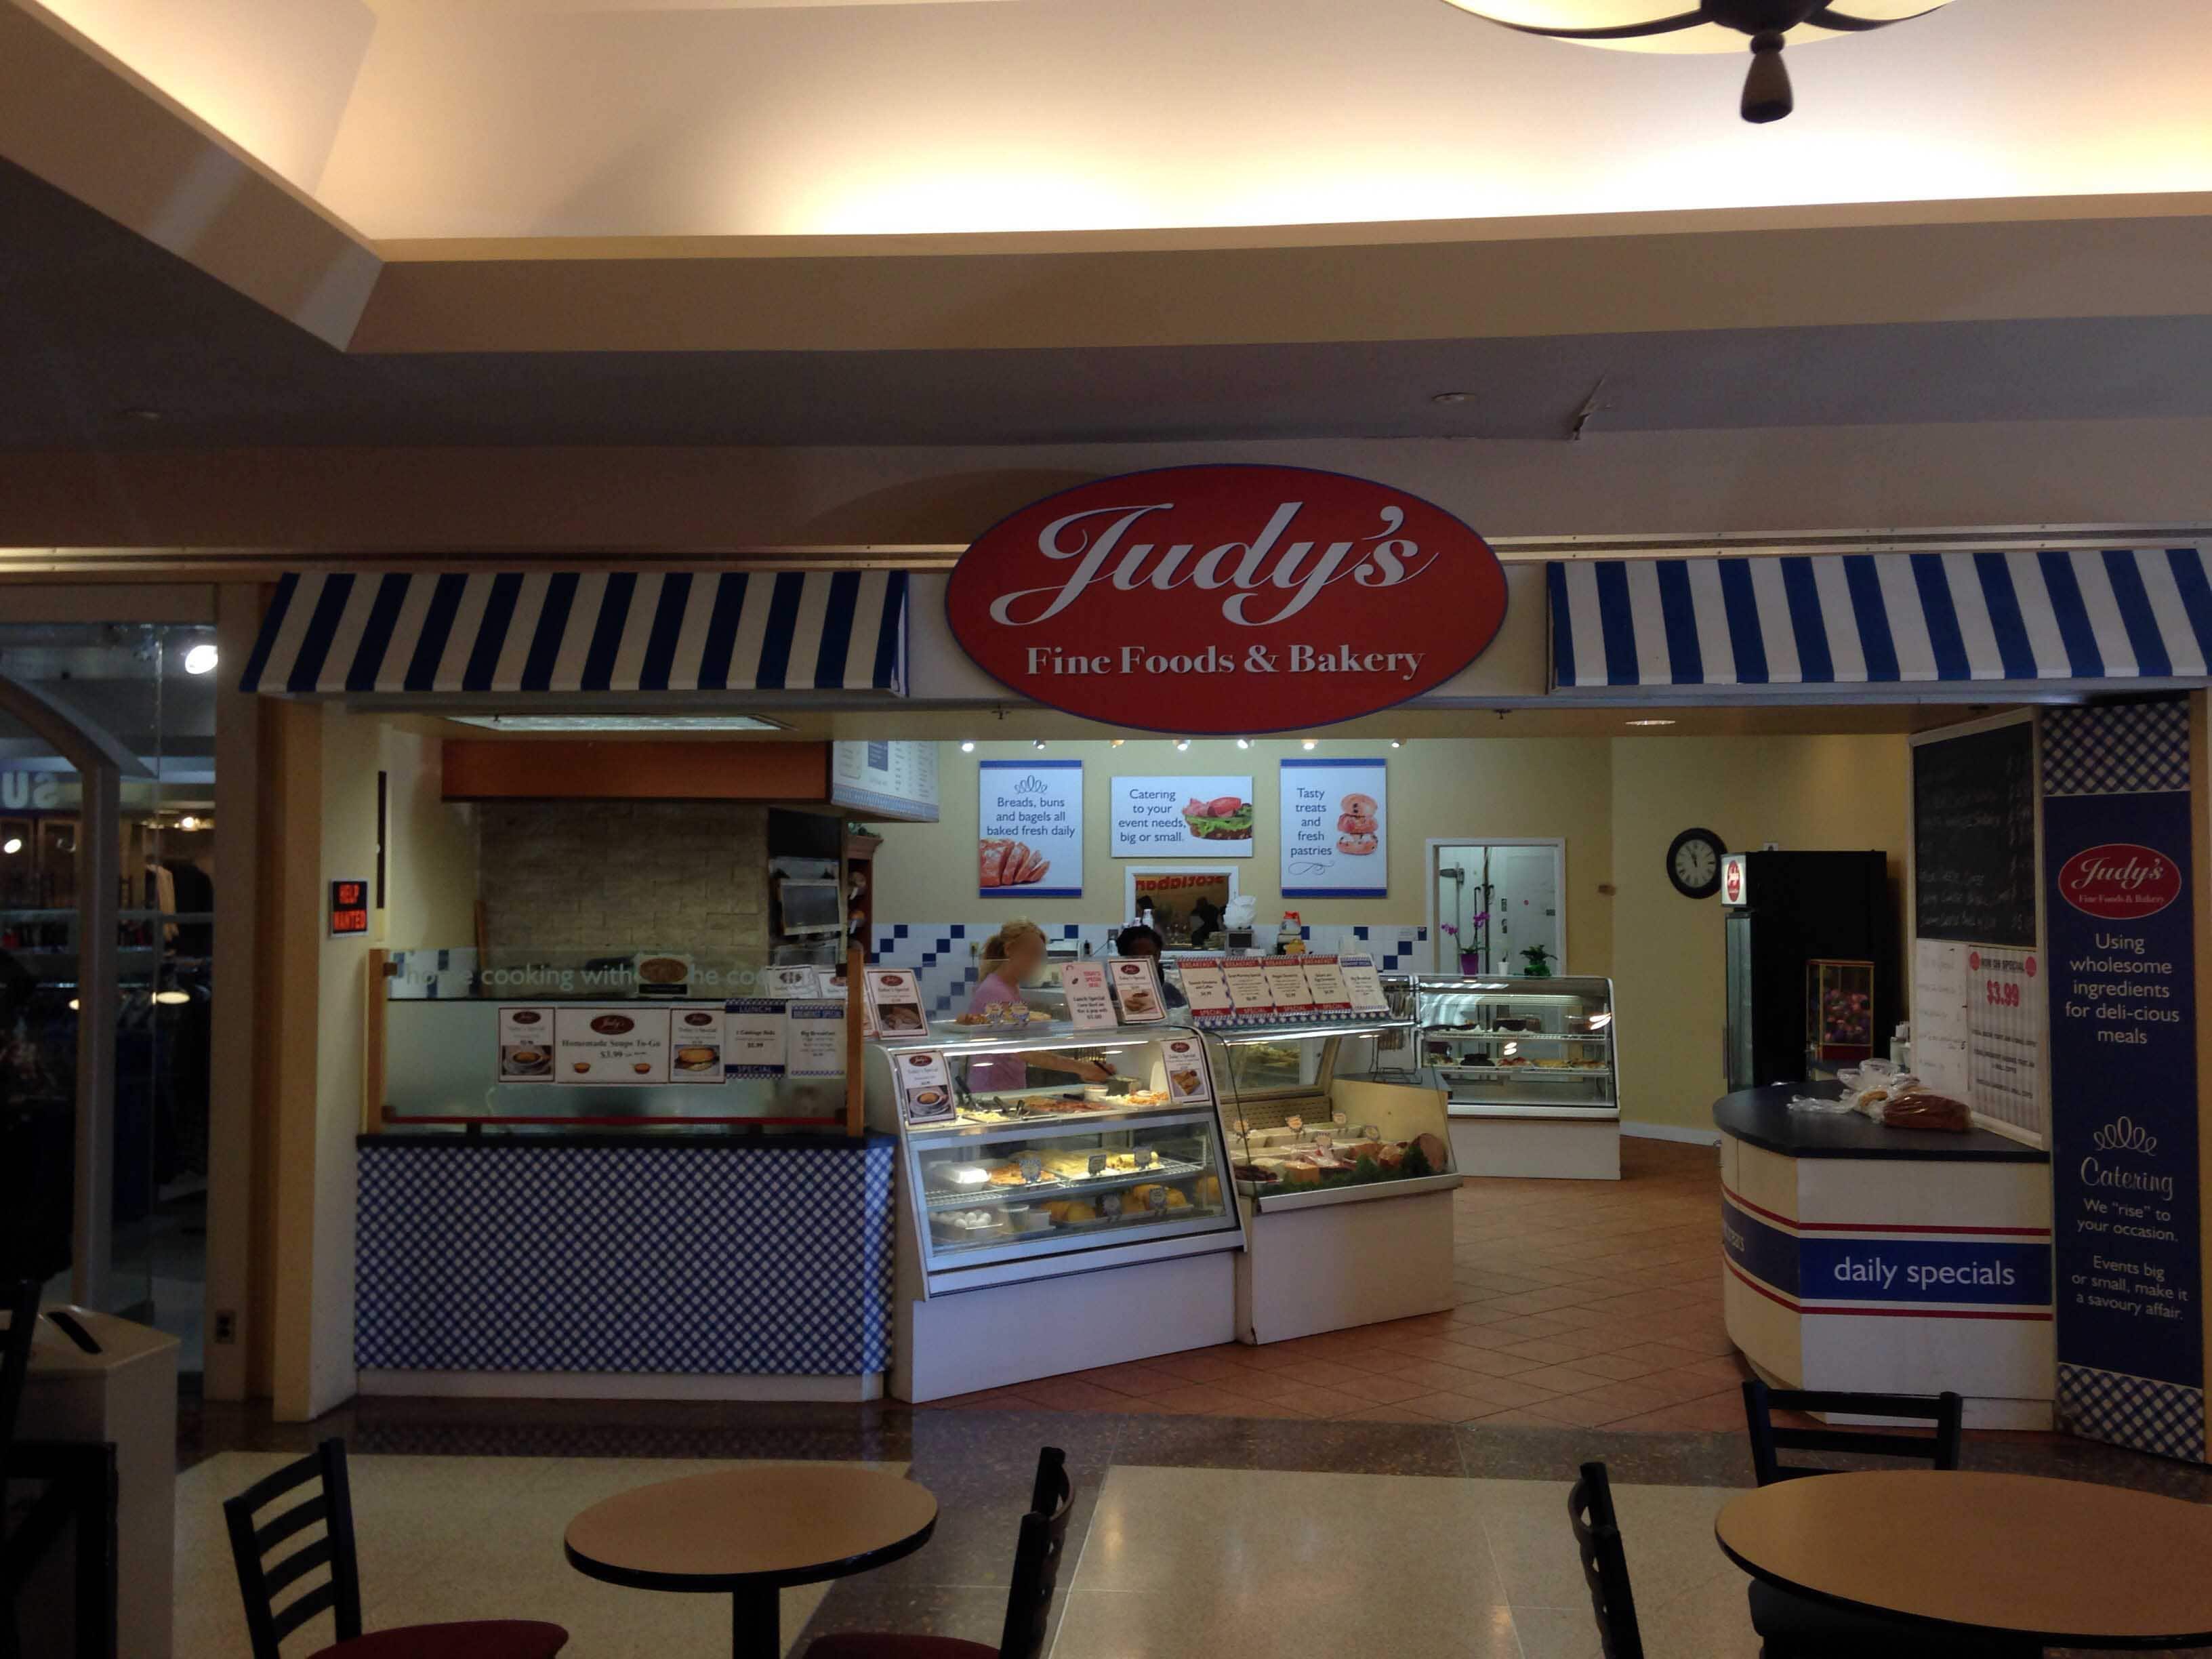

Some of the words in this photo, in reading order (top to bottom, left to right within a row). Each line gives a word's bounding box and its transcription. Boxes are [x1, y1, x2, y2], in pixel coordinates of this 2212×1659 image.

[990, 501, 1439, 626] Judy's
[1025, 646, 1111, 676] Fine
[1118, 645, 1235, 674] Foods
[1245, 644, 1279, 673] &
[1290, 644, 1425, 681] Bakery
[997, 796, 1036, 808] Breads,
[1040, 796, 1065, 807] buns
[1129, 789, 1176, 802] Catering
[1297, 787, 1324, 801] Tasty
[1133, 804, 1143, 815] to
[1146, 806, 1172, 817] your
[1296, 802, 1326, 813] treats
[996, 811, 1015, 821] and
[1018, 811, 1051, 824] bagels
[1054, 811, 1065, 821] all
[1118, 819, 1148, 829] event
[1151, 817, 1186, 830] needs,
[1301, 816, 1320, 827] and
[986, 825, 1019, 836] baked
[1021, 824, 1049, 836] fresh
[1052, 824, 1076, 838] daily
[1120, 831, 1134, 844] big
[1138, 833, 1151, 842] or
[1154, 831, 1184, 842] small.
[1298, 830, 1324, 841] fresh
[1290, 844, 1332, 857] pastries
[2071, 857, 2163, 890] Judy's
[2095, 933, 2145, 954] Using
[2070, 956, 2172, 974] wholesome
[480, 962, 573, 990] cooking
[1987, 979, 2020, 1008] $3.99
[2073, 980, 2170, 1000] ingredients
[2066, 1002, 2090, 1017] for
[2096, 1004, 2179, 1022] deli-cious
[562, 1040, 607, 1048] Homemade
[2097, 1027, 2148, 1044] meals
[2081, 1157, 2173, 1201] Catering
[2083, 1197, 2108, 1213] We
[2156, 1207, 2171, 1221] to
[2077, 1219, 2109, 1233] your
[2114, 1223, 2178, 1242] occasion.
[1835, 1256, 1898, 1290] daily
[1907, 1261, 2015, 1290] specials
[2093, 1255, 2139, 1274] Events
[2144, 1263, 2165, 1282] big
[2072, 1274, 2086, 1284] or
[2091, 1277, 2130, 1293] small,
[2135, 1284, 2173, 1299] make
[2177, 1288, 2188, 1302] it
[2076, 1294, 2083, 1304] a
[2088, 1295, 2142, 1315] savoury
[2146, 1304, 2183, 1320] affair.
